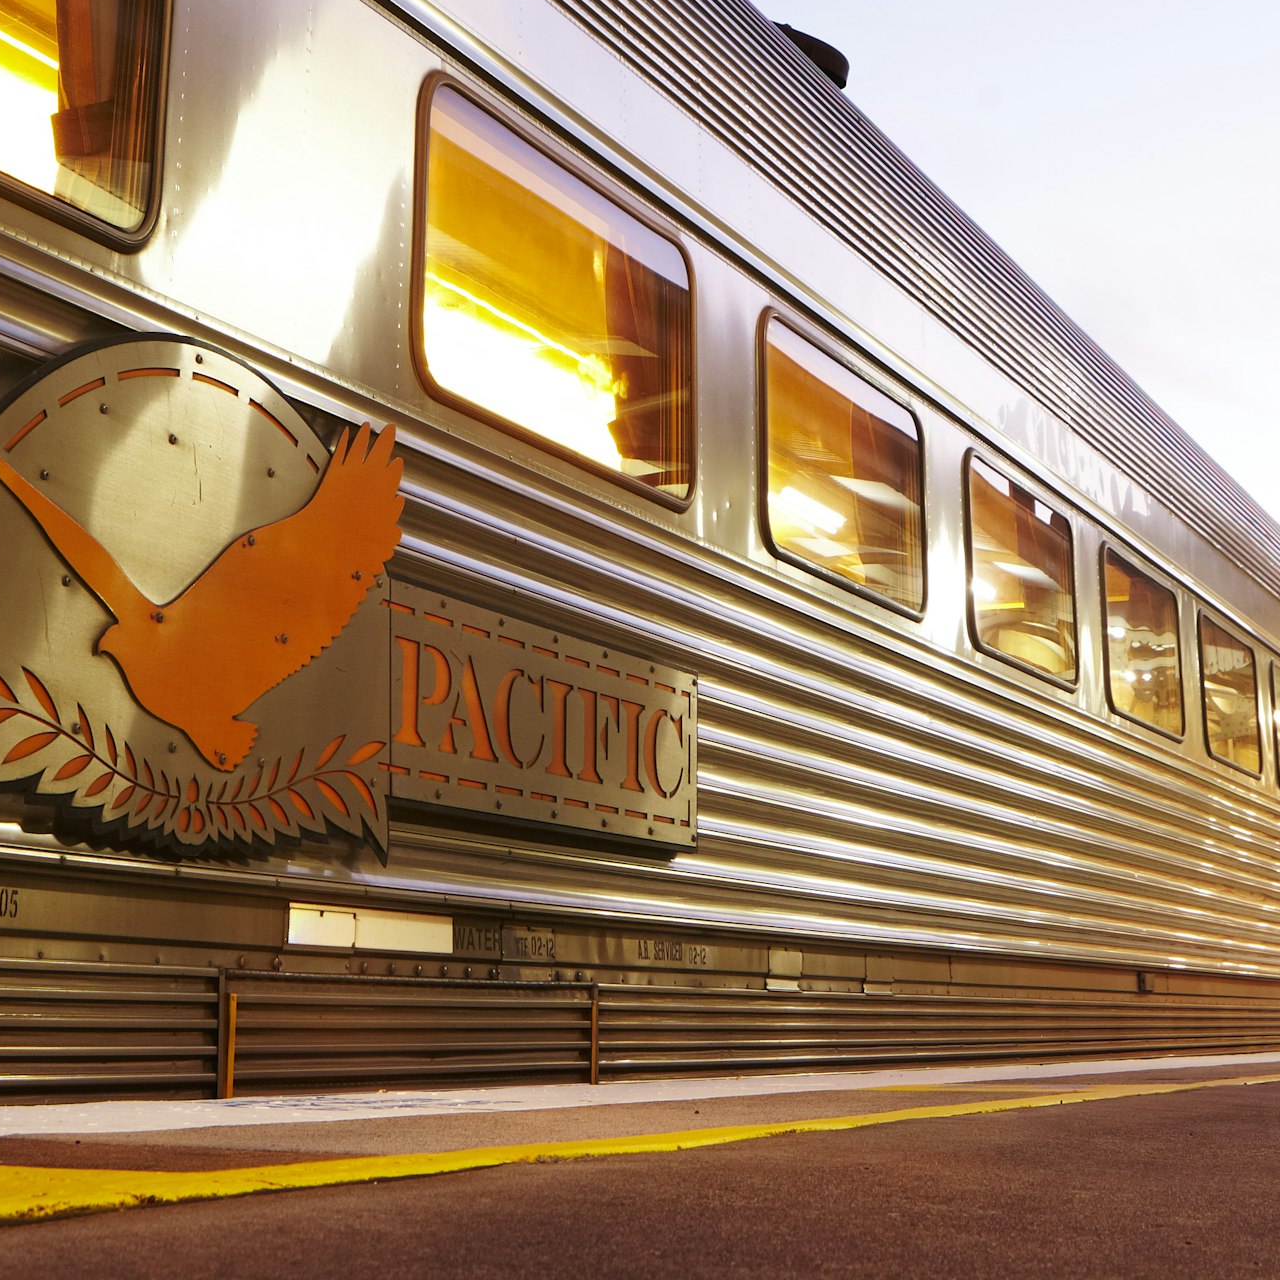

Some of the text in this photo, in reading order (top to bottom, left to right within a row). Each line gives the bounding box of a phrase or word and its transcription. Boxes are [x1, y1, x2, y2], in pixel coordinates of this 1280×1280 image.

[393, 635, 684, 799] PACIFIC
[453, 927, 501, 952] WATER
[654, 939, 683, 962] SERVICED
